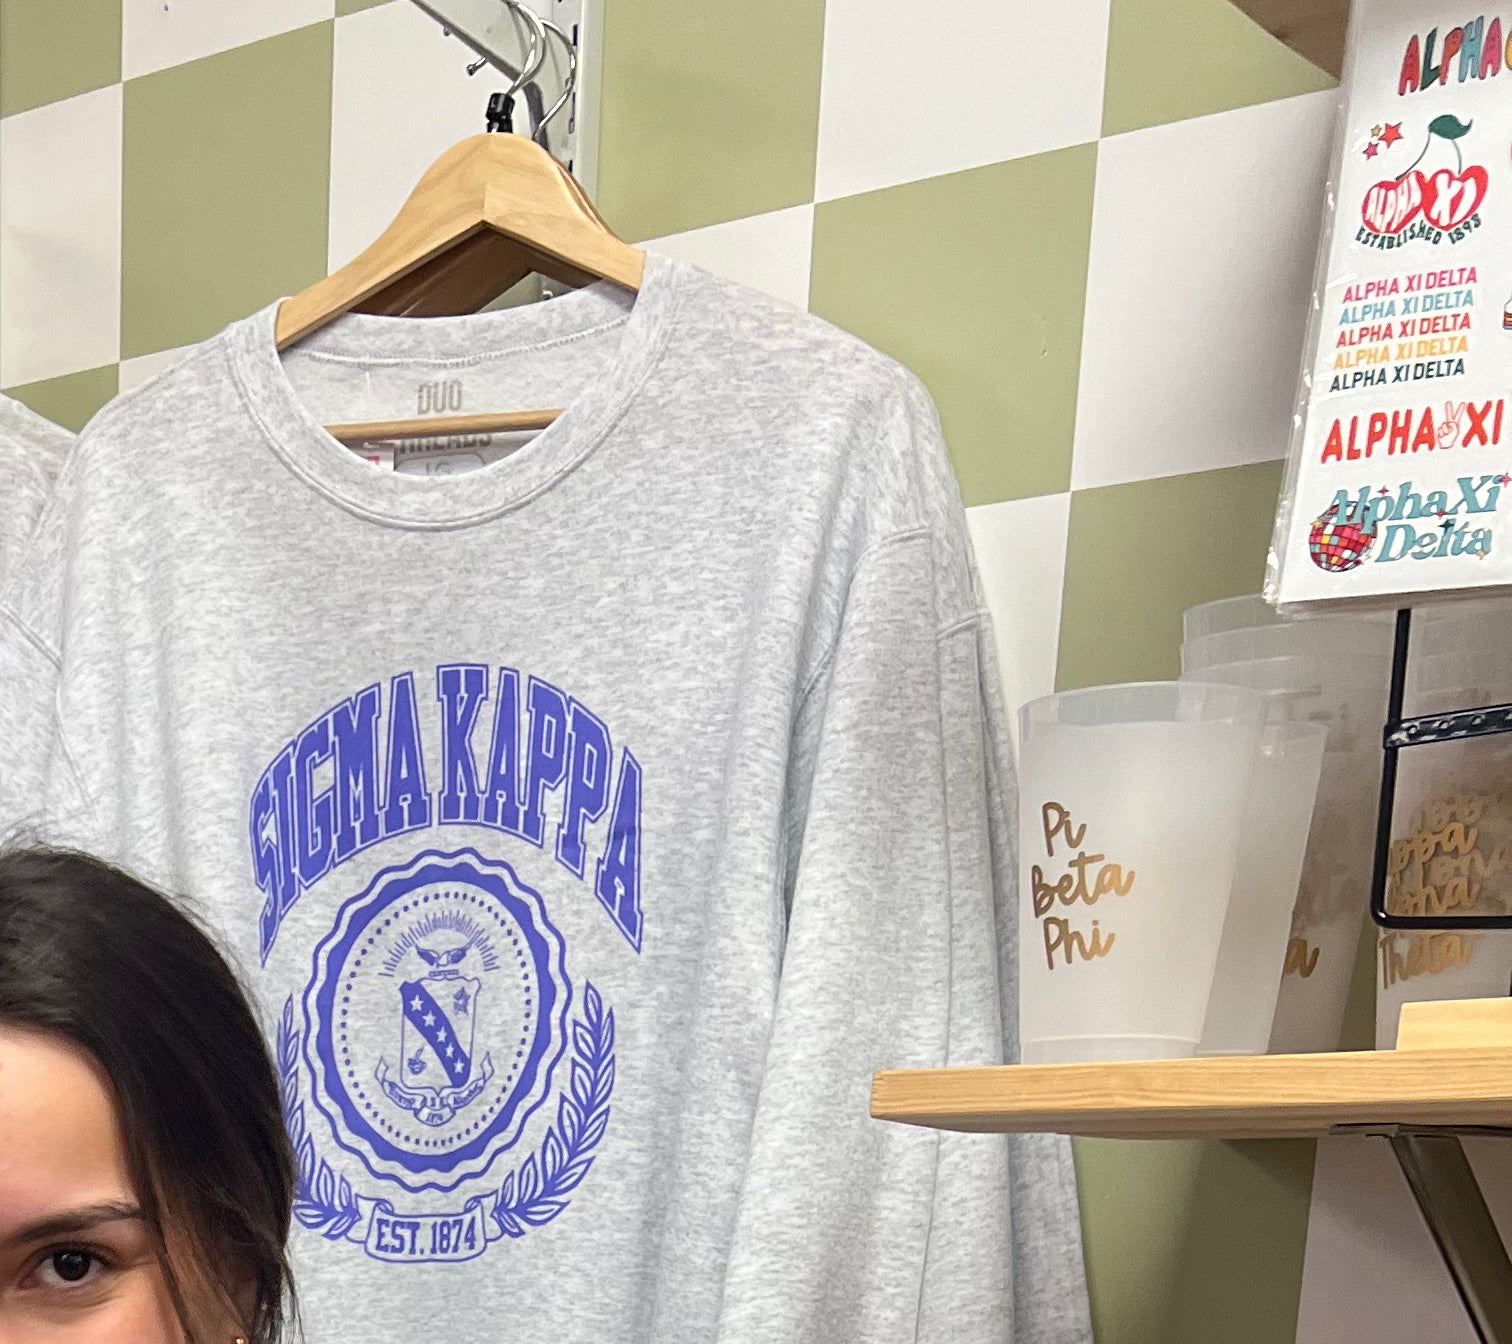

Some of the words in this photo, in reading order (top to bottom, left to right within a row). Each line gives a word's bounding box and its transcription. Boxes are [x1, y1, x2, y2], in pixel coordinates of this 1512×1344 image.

[1398, 15, 1502, 97] ALPHA
[1365, 171, 1423, 233] ALPHA
[1429, 172, 1478, 227] XI
[1355, 219, 1442, 250] ESTABLISHED
[1339, 301, 1396, 326] ALPHA
[1401, 296, 1419, 316] XI
[1421, 289, 1474, 312] DELTA
[1342, 277, 1399, 304] ALPHA
[1404, 274, 1423, 293] XI
[1425, 266, 1478, 290] DELTA
[1333, 345, 1390, 370] ALPHA
[1395, 340, 1413, 360] XI
[1416, 335, 1469, 358] DELTA
[1336, 323, 1393, 348] ALPHA
[1398, 319, 1416, 338] XI
[1419, 312, 1471, 335] DELTA
[417, 379, 463, 415] DUO
[1329, 367, 1387, 393] ALPHA
[1392, 364, 1410, 383] XI
[1413, 358, 1465, 381] DELTA
[1320, 405, 1436, 464] ALPHA
[1461, 398, 1505, 448] XI
[1318, 481, 1448, 535] Alpha
[1447, 474, 1503, 515] Xi
[1374, 518, 1493, 563] Delta
[249, 670, 432, 968] SIGMA
[437, 663, 644, 955] KAPPA
[1042, 801, 1087, 857] Pi
[1031, 851, 1135, 918] Beta
[1042, 915, 1116, 970] Phi
[375, 1218, 424, 1255] EST.
[430, 1216, 476, 1254] 1874
